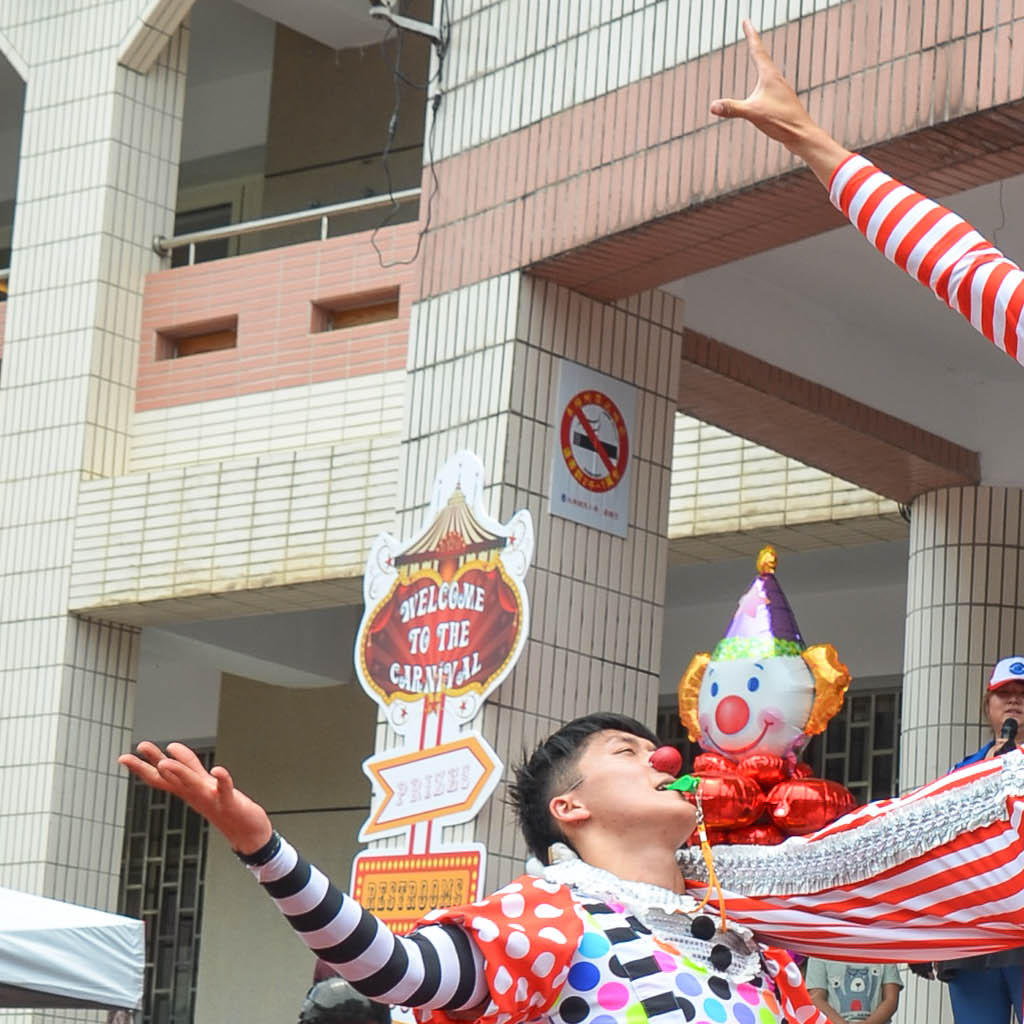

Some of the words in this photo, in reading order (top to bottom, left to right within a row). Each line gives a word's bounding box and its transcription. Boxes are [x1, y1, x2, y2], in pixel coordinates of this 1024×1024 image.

[400, 581, 486, 623] WELCOME
[408, 626, 431, 655] TO
[436, 620, 471, 651] THE
[389, 653, 482, 692] CARNIVAL
[396, 764, 472, 807] PRIZES
[366, 878, 464, 912] RESTROOMS
